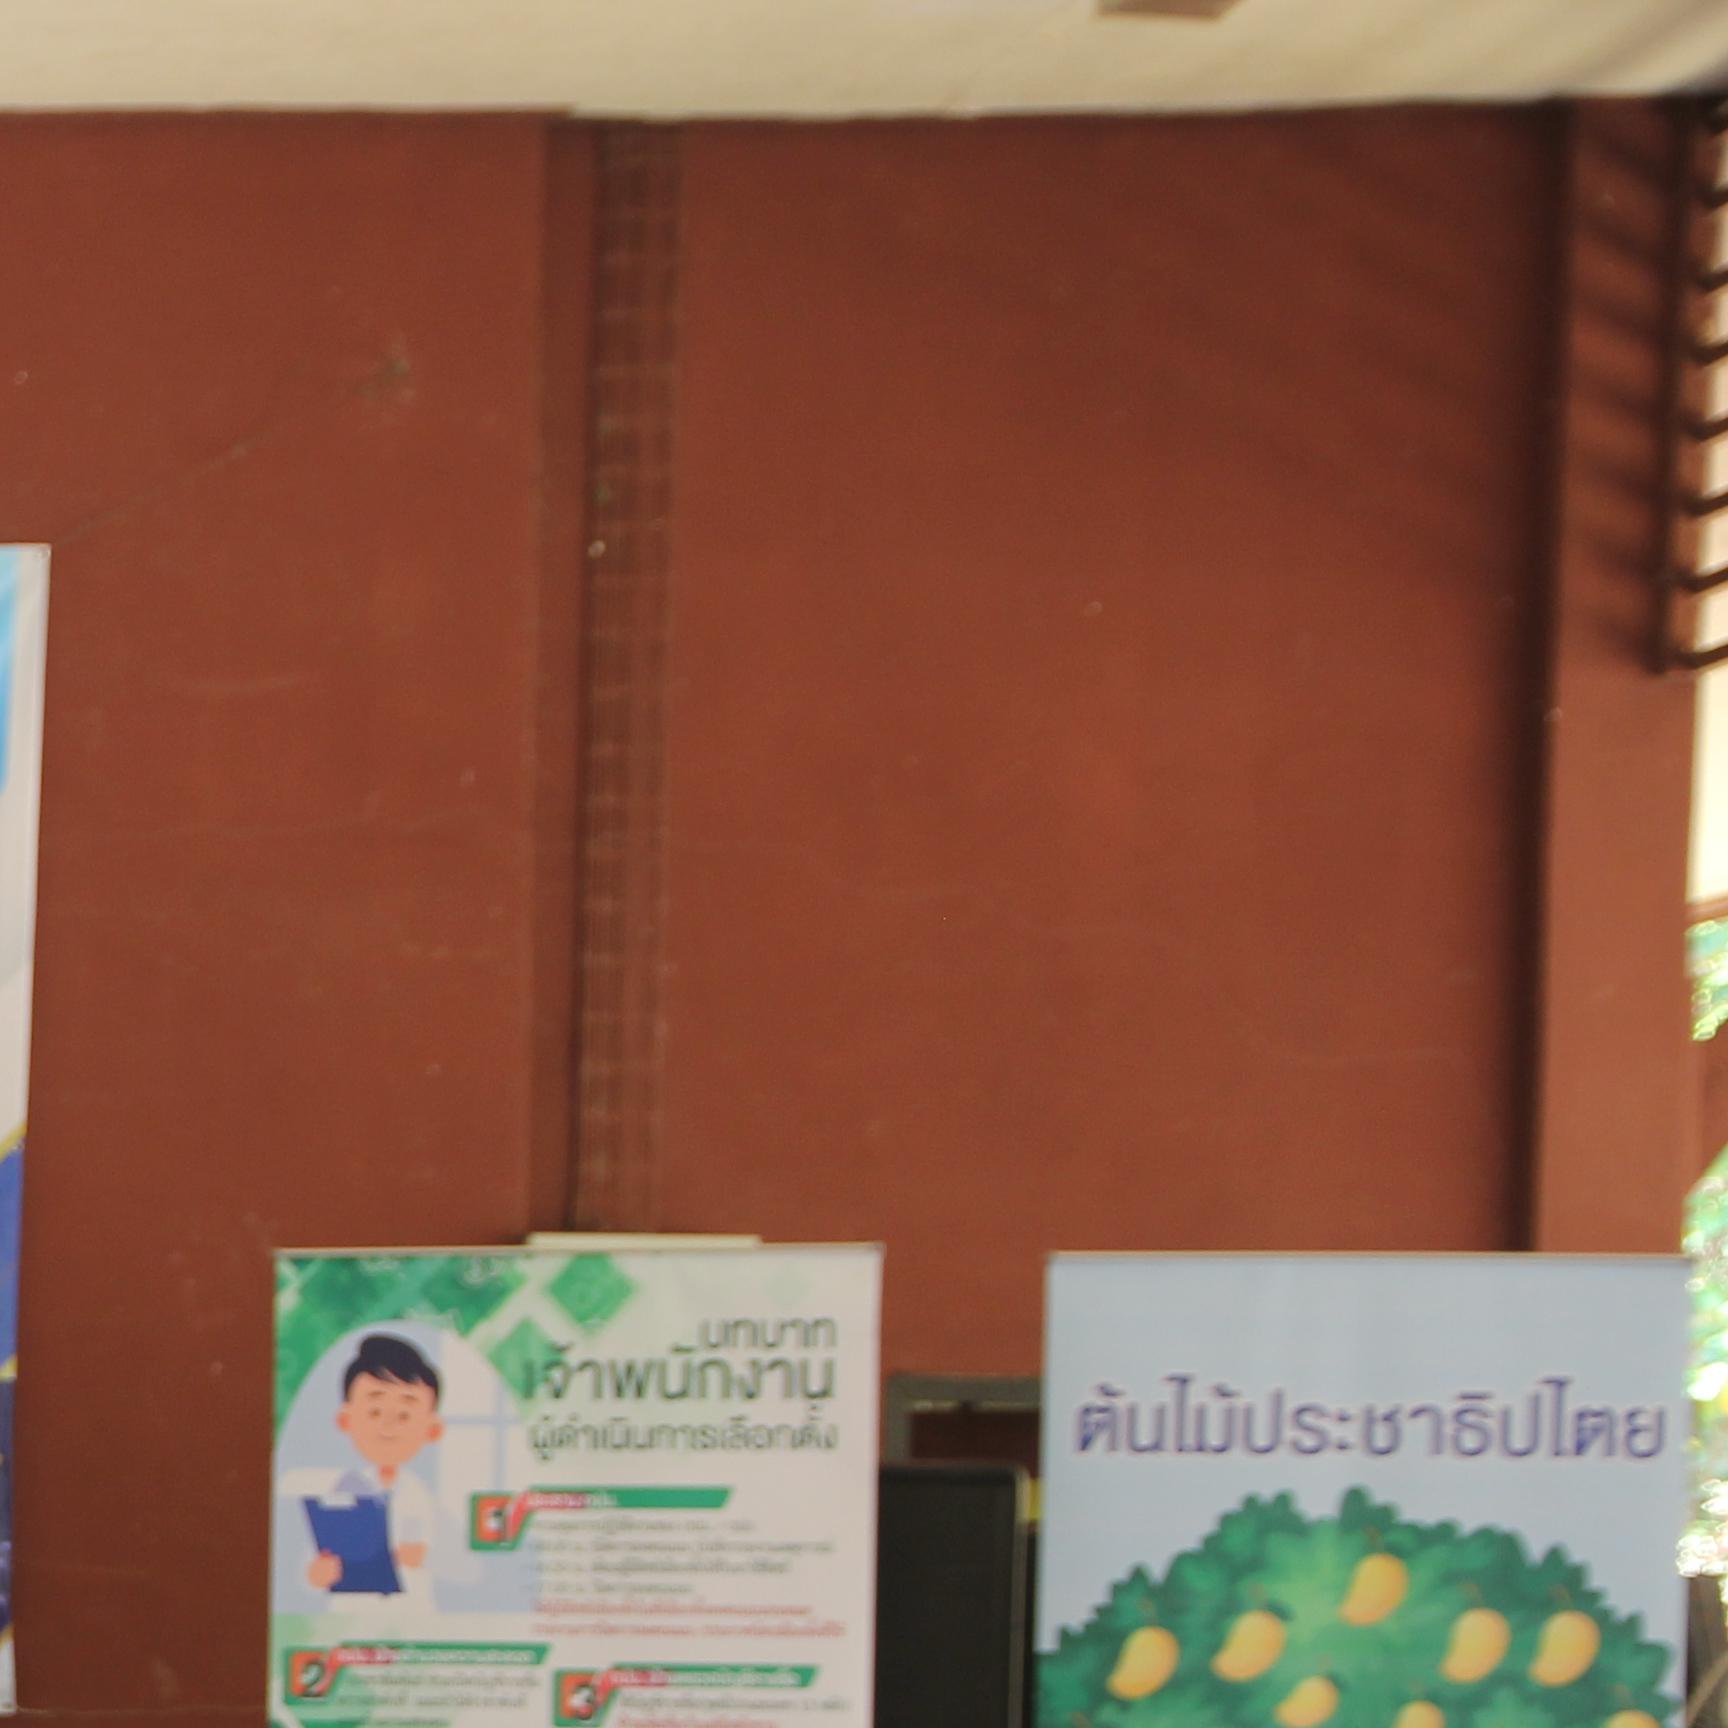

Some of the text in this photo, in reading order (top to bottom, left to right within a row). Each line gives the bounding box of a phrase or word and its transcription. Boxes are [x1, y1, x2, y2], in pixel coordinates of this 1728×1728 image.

[699, 1314, 836, 1351] บทบาท
[523, 1343, 835, 1404] เจ้าพนักงาน
[529, 1406, 838, 1462] ผู้ดำเนินการเลือกตั้ง
[1075, 1373, 1667, 1459] ต้นไม้ประชาธิปไตย
